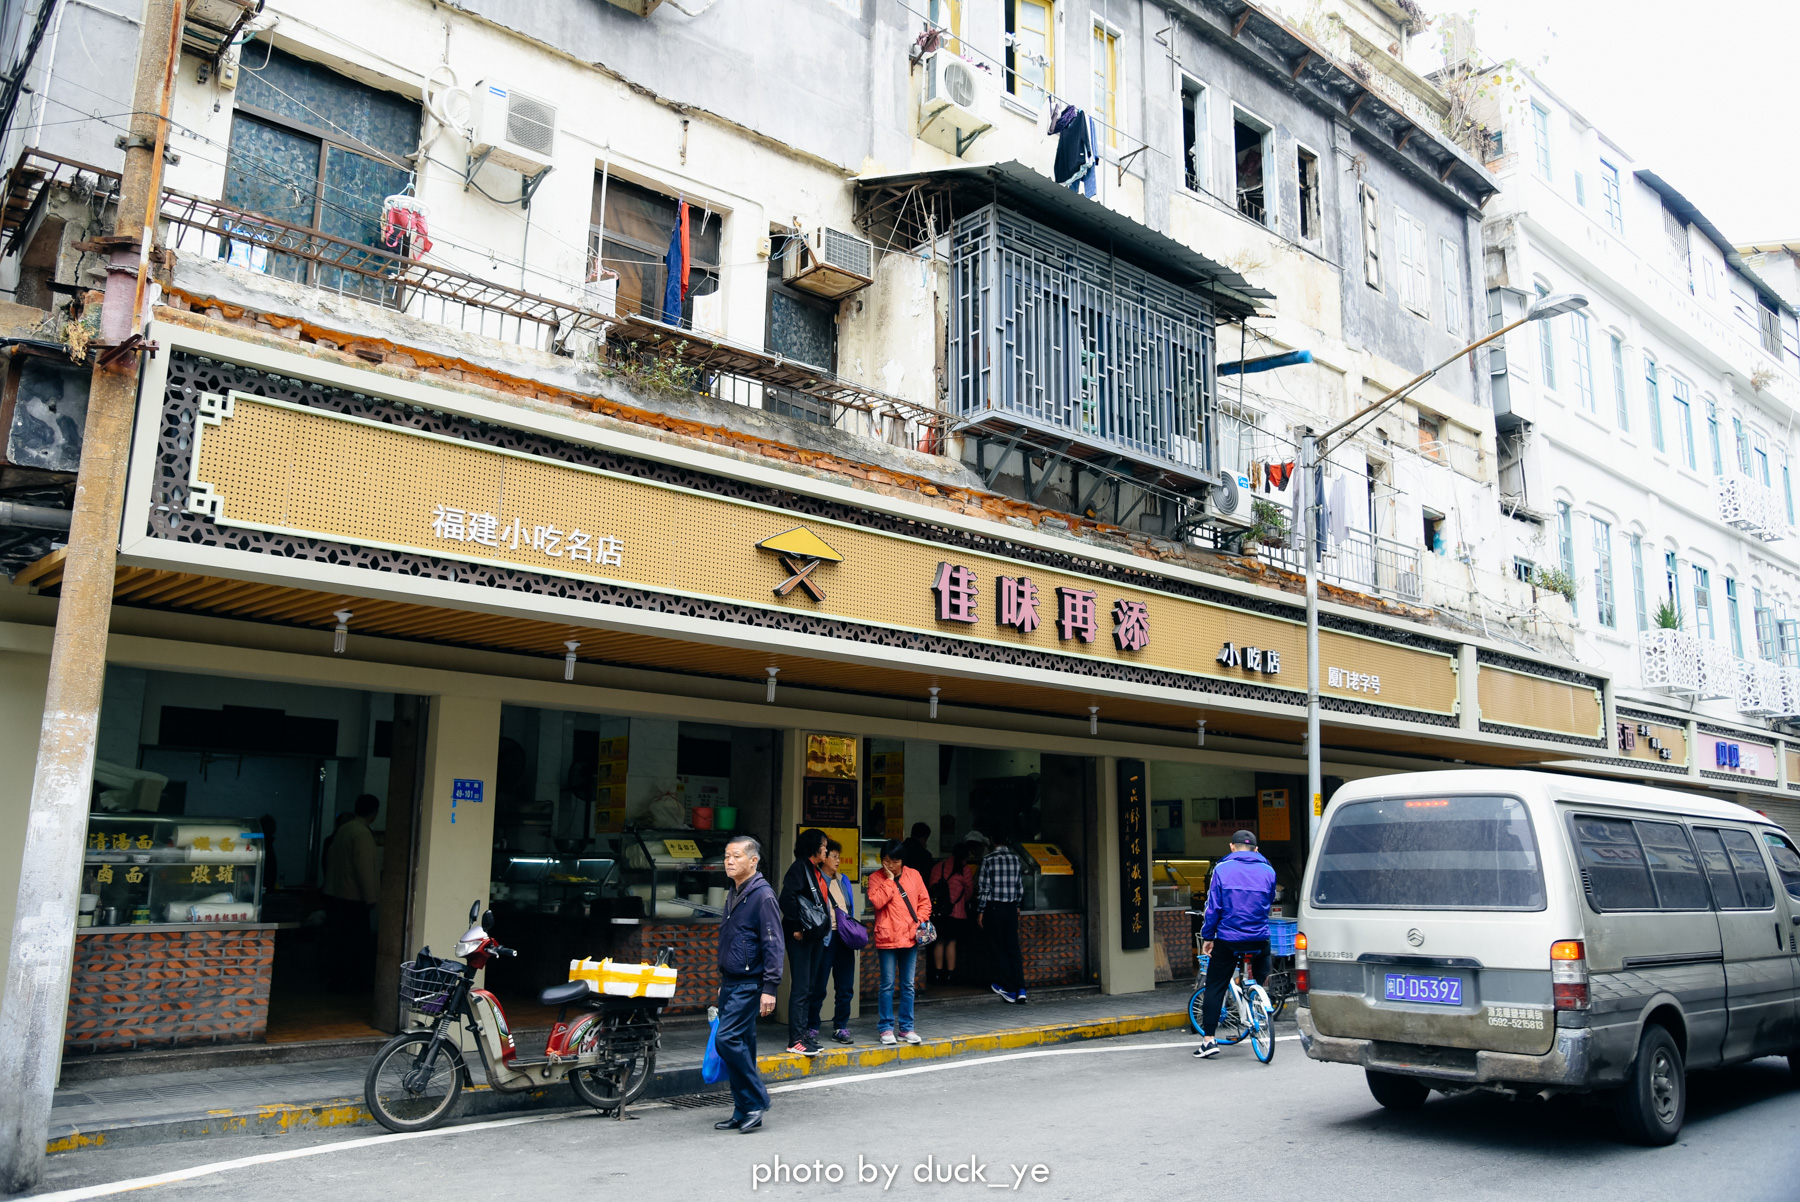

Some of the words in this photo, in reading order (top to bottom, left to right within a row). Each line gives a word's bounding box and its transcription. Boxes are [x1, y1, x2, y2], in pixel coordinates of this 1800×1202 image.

[431, 504, 624, 567] 福建小吃名店
[931, 562, 1150, 651] 佳味再添
[1217, 642, 1281, 674] 小吃店
[1328, 667, 1380, 694] 厦门老字号
[1488, 1017, 1544, 1030] 0592-5215813
